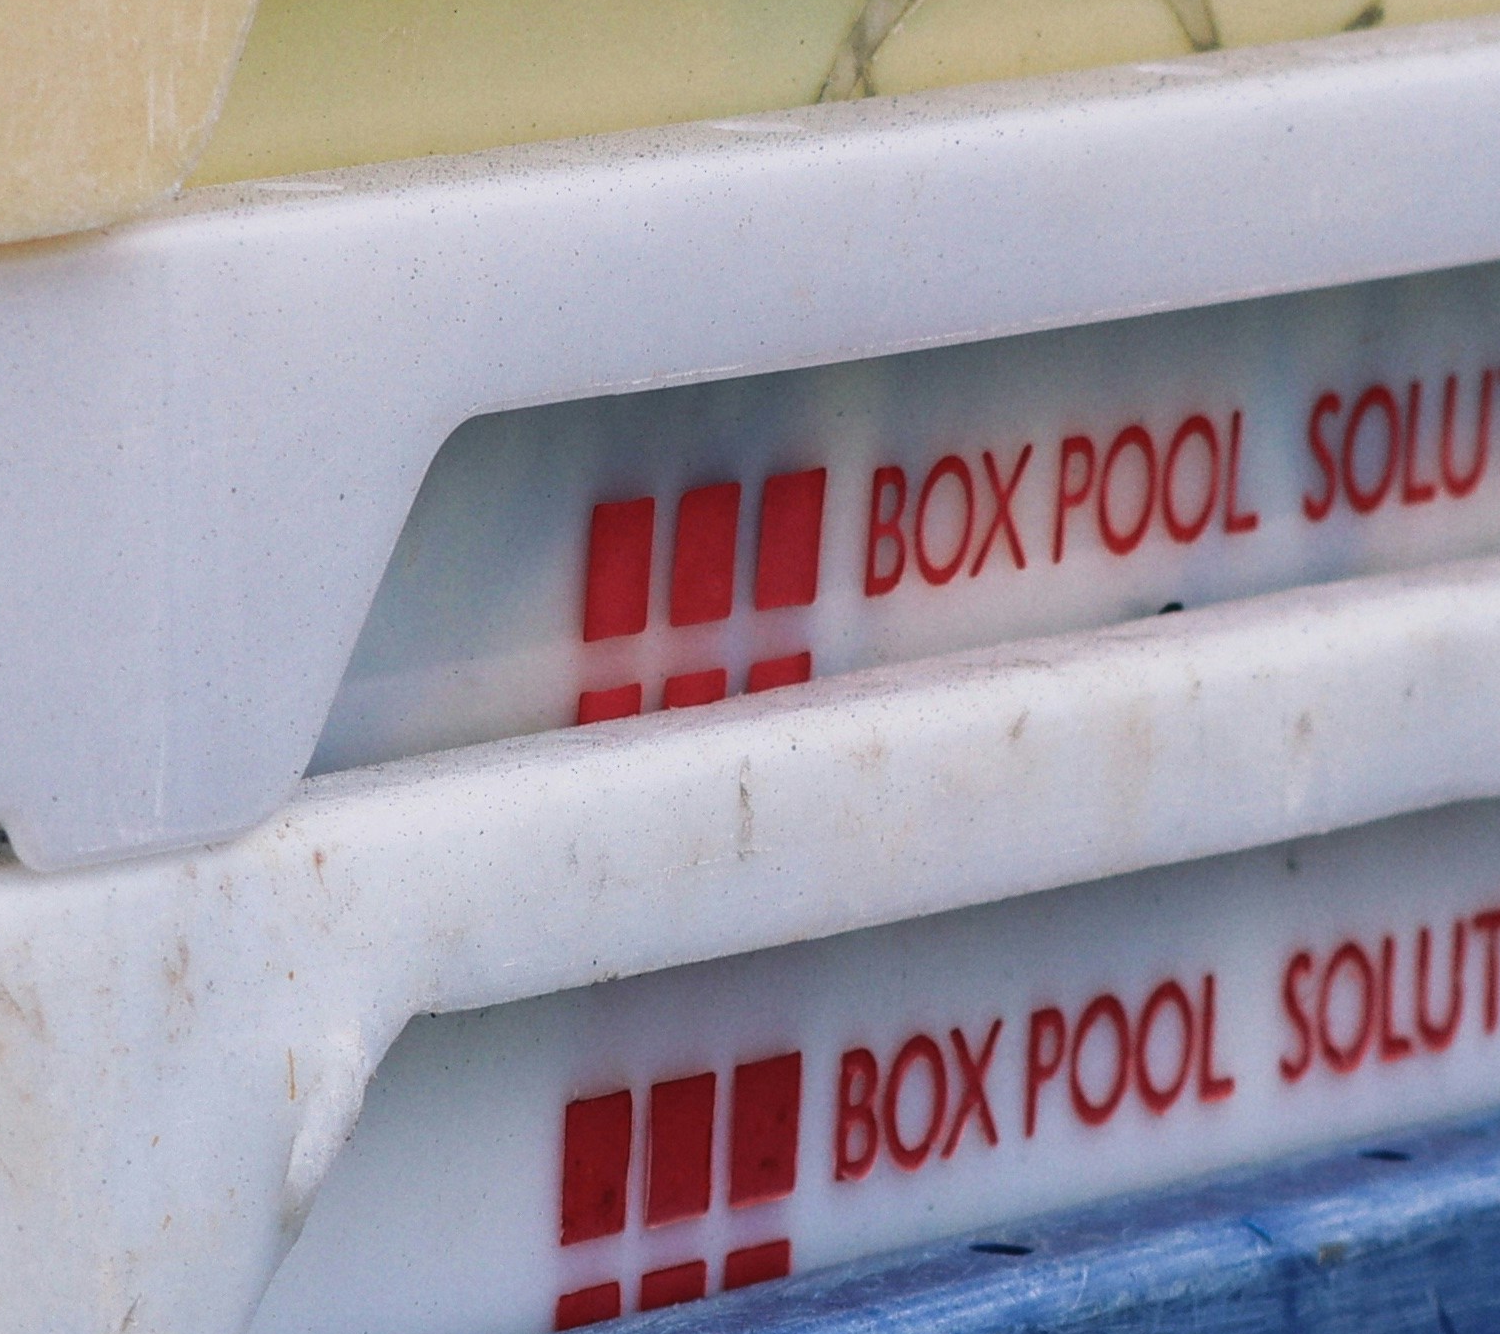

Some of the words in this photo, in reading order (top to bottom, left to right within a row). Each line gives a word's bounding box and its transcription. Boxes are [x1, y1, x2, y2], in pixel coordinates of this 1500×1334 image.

[860, 444, 1033, 599] BOX
[1050, 410, 1258, 564] POOL
[833, 1017, 1004, 1182] BOX
[1024, 975, 1236, 1138] POOL
